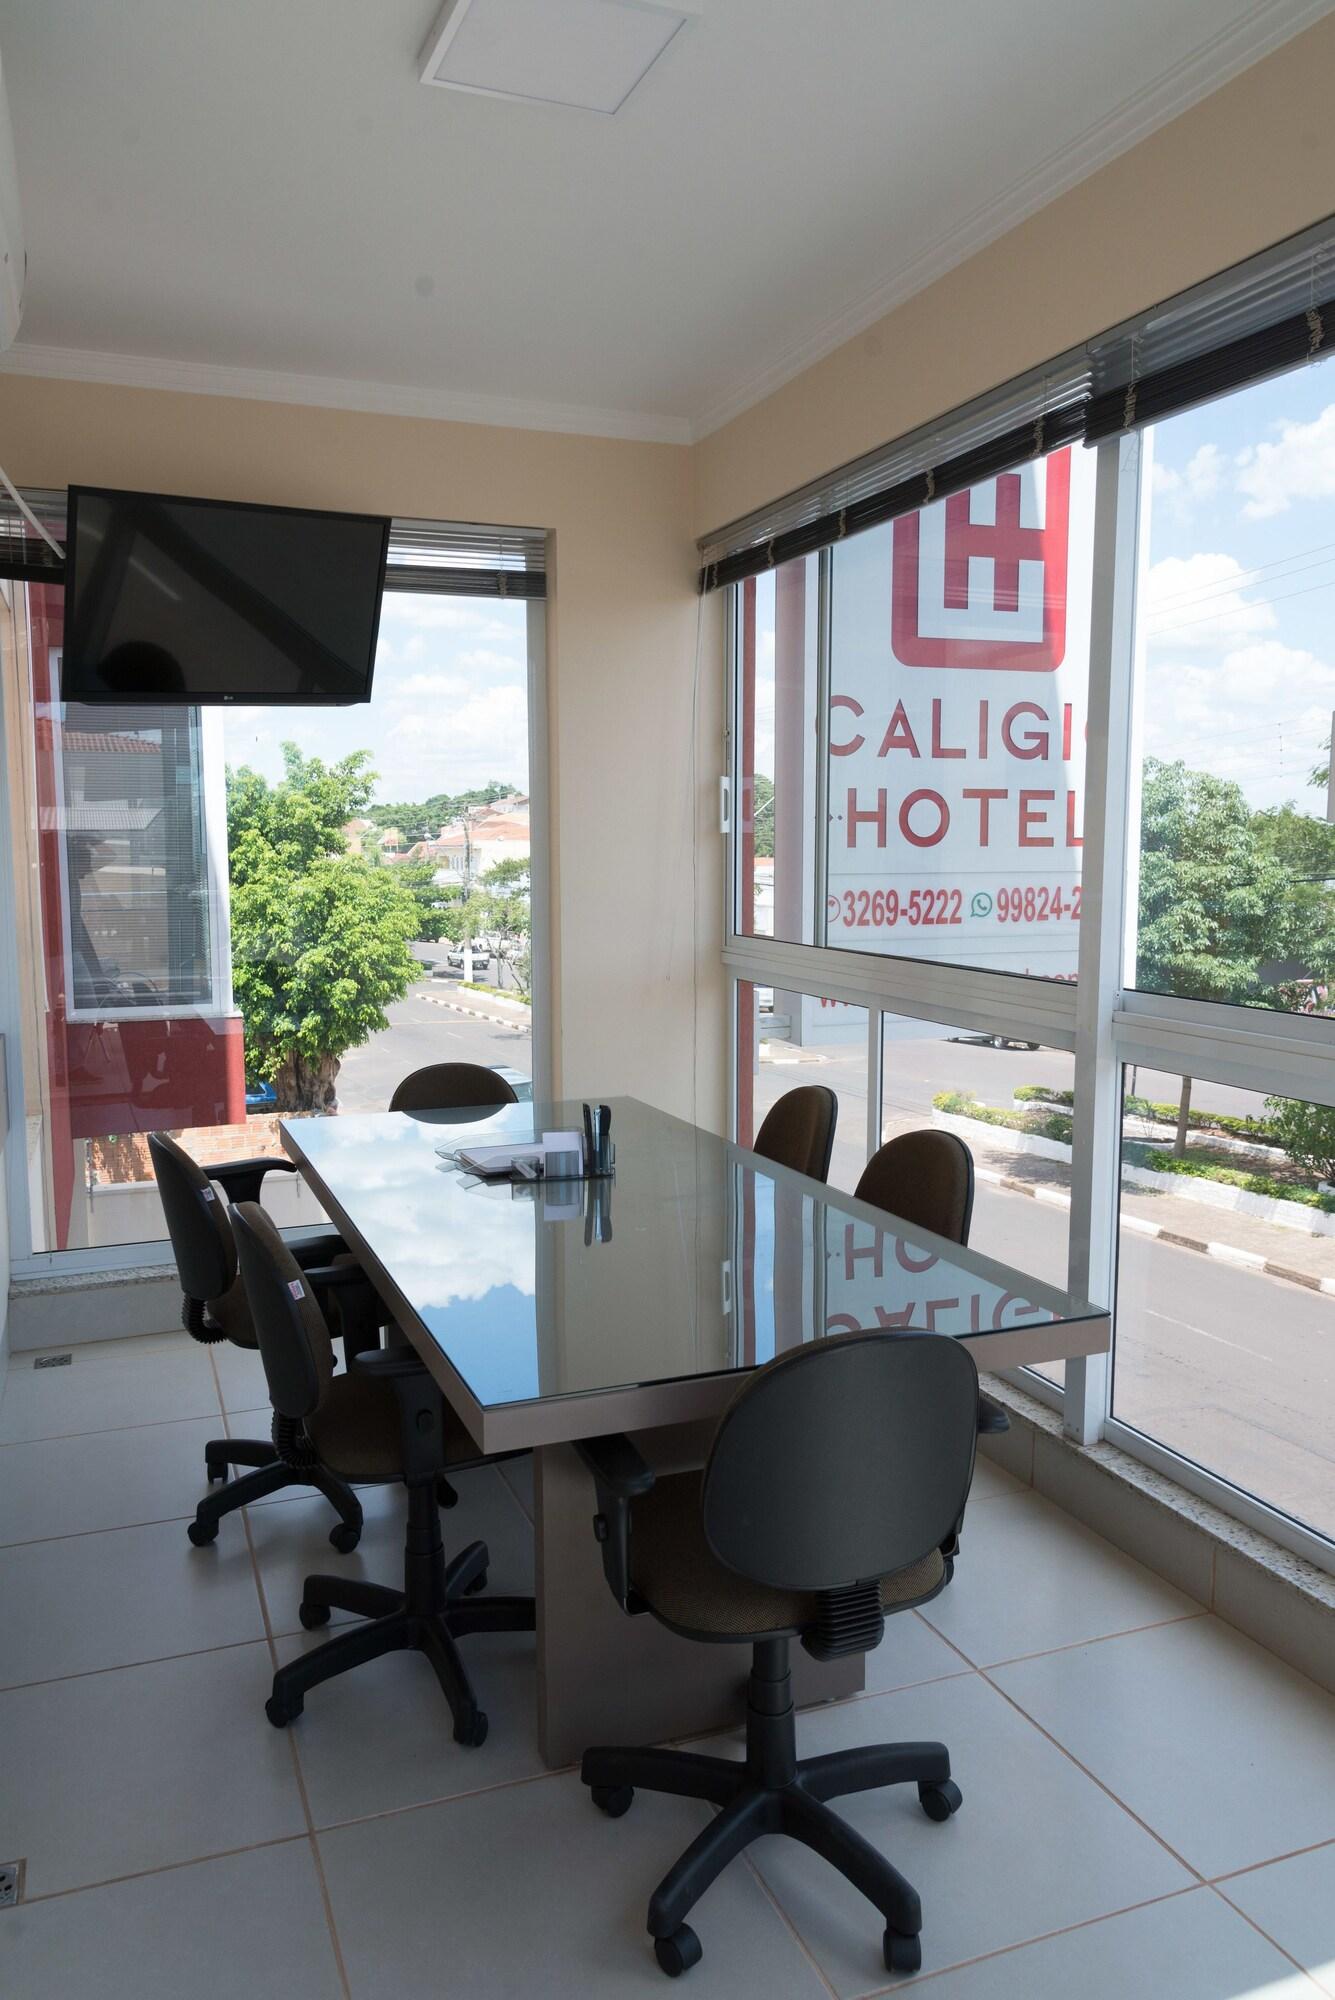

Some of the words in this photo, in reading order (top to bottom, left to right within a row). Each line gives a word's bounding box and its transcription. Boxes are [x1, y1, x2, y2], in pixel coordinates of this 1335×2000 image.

[829, 695, 1088, 761] CALIGI
[847, 788, 1083, 848] HOTEL
[842, 888, 963, 928] 3269-5222
